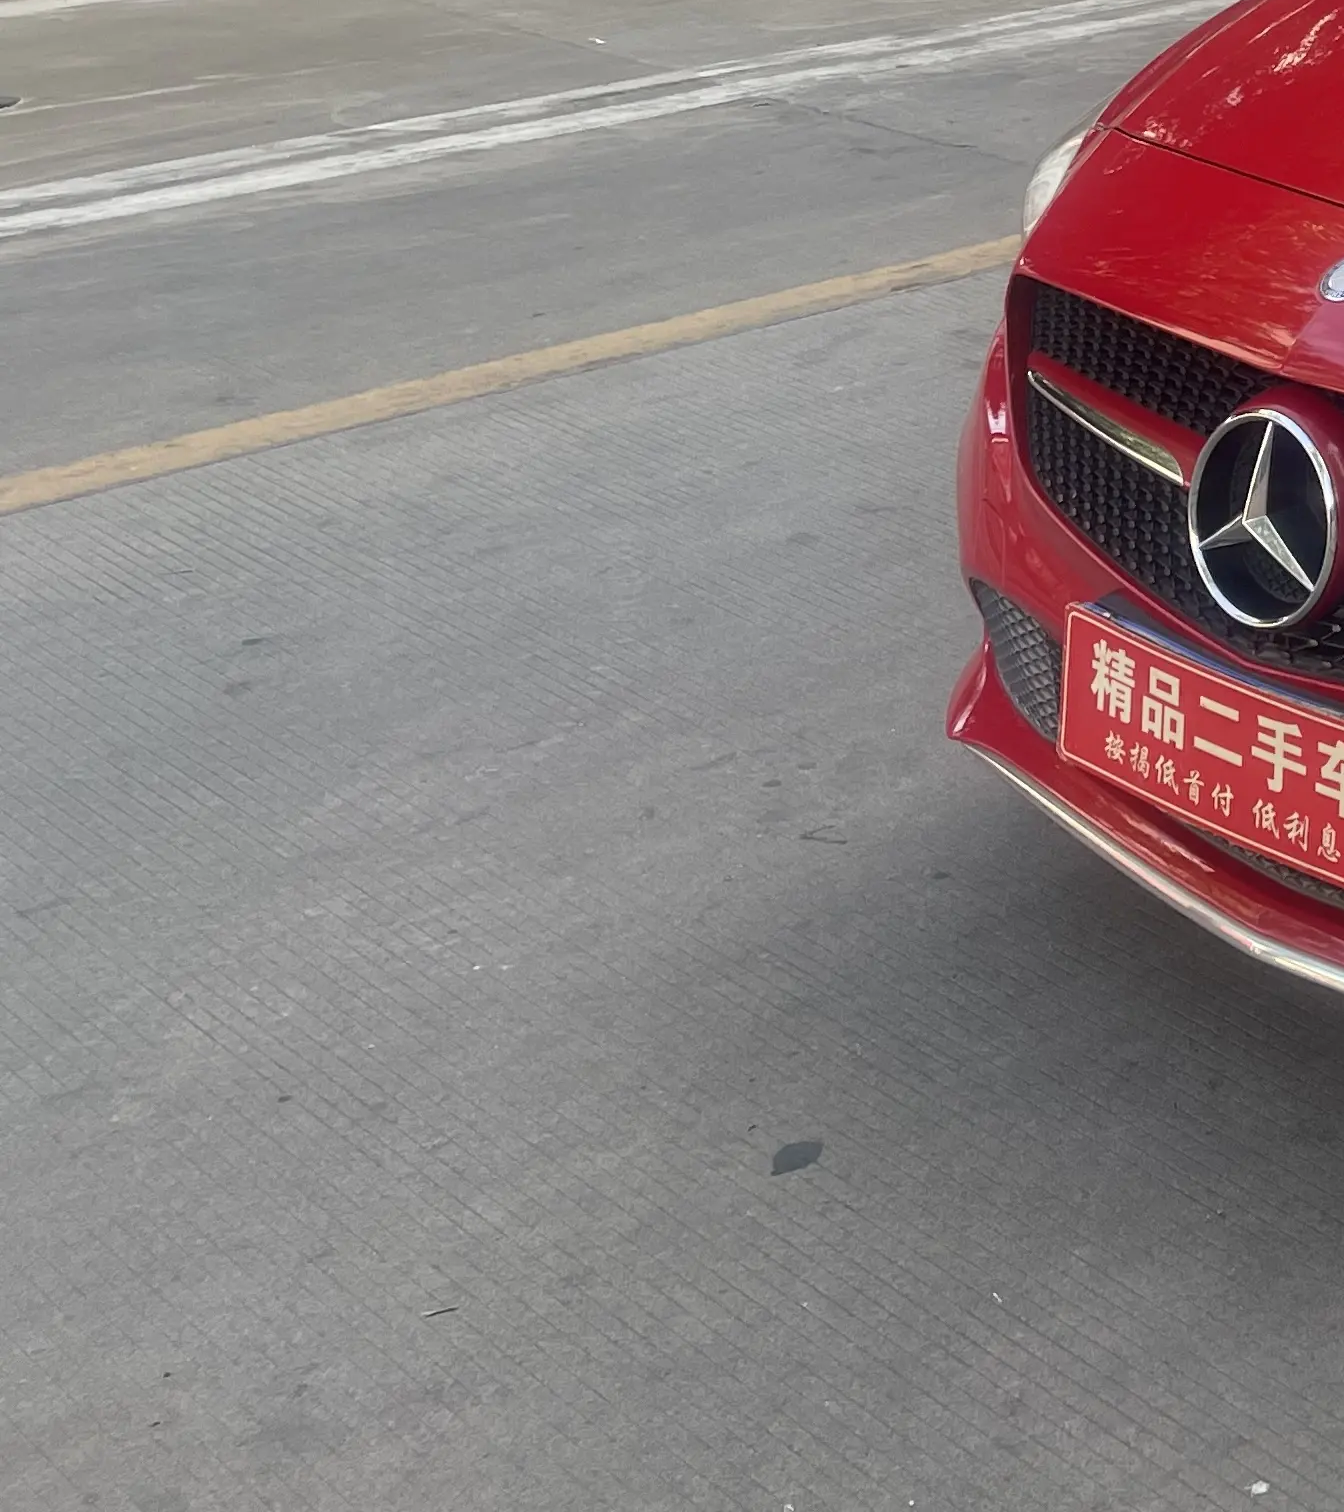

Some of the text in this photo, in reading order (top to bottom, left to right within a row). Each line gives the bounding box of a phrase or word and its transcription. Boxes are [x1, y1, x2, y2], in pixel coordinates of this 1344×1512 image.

[1104, 730, 1341, 863] 按揭低首付 低利息
